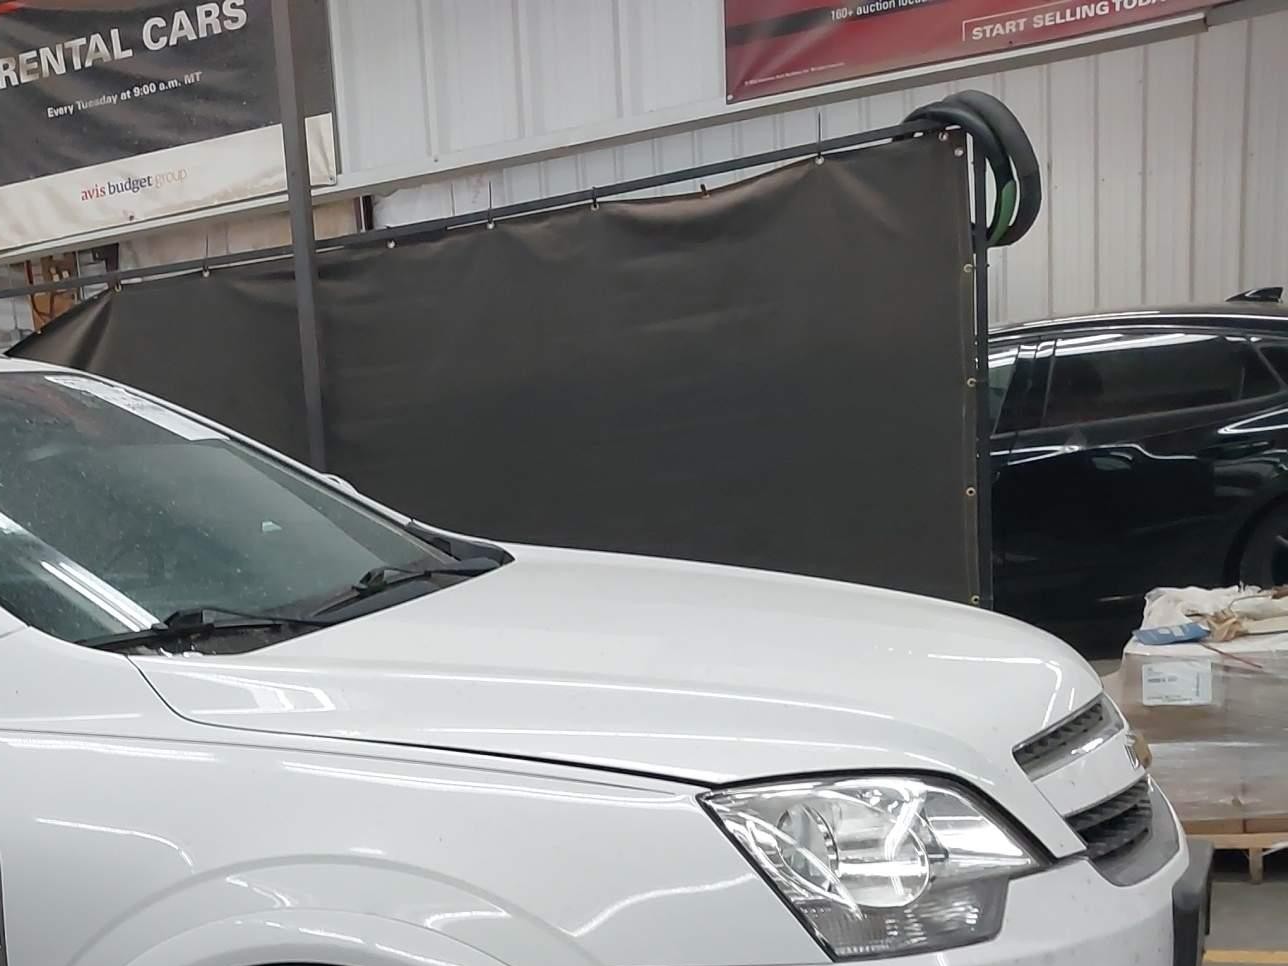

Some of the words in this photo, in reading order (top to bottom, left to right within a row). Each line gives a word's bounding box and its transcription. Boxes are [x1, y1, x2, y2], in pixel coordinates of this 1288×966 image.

[142, 0, 247, 51] CARS
[856, 0, 896, 15] auction
[971, 17, 1027, 41] START
[1032, 0, 1109, 28] SELLING
[1113, 0, 1166, 12] TOD
[47, 103, 74, 118] Every
[76, 93, 119, 111] Tuesday
[120, 90, 132, 101] at
[133, 82, 157, 97] 9:00
[159, 78, 182, 91] a.m.
[183, 71, 203, 85] MT
[81, 184, 106, 200] avis
[107, 176, 152, 195] budget
